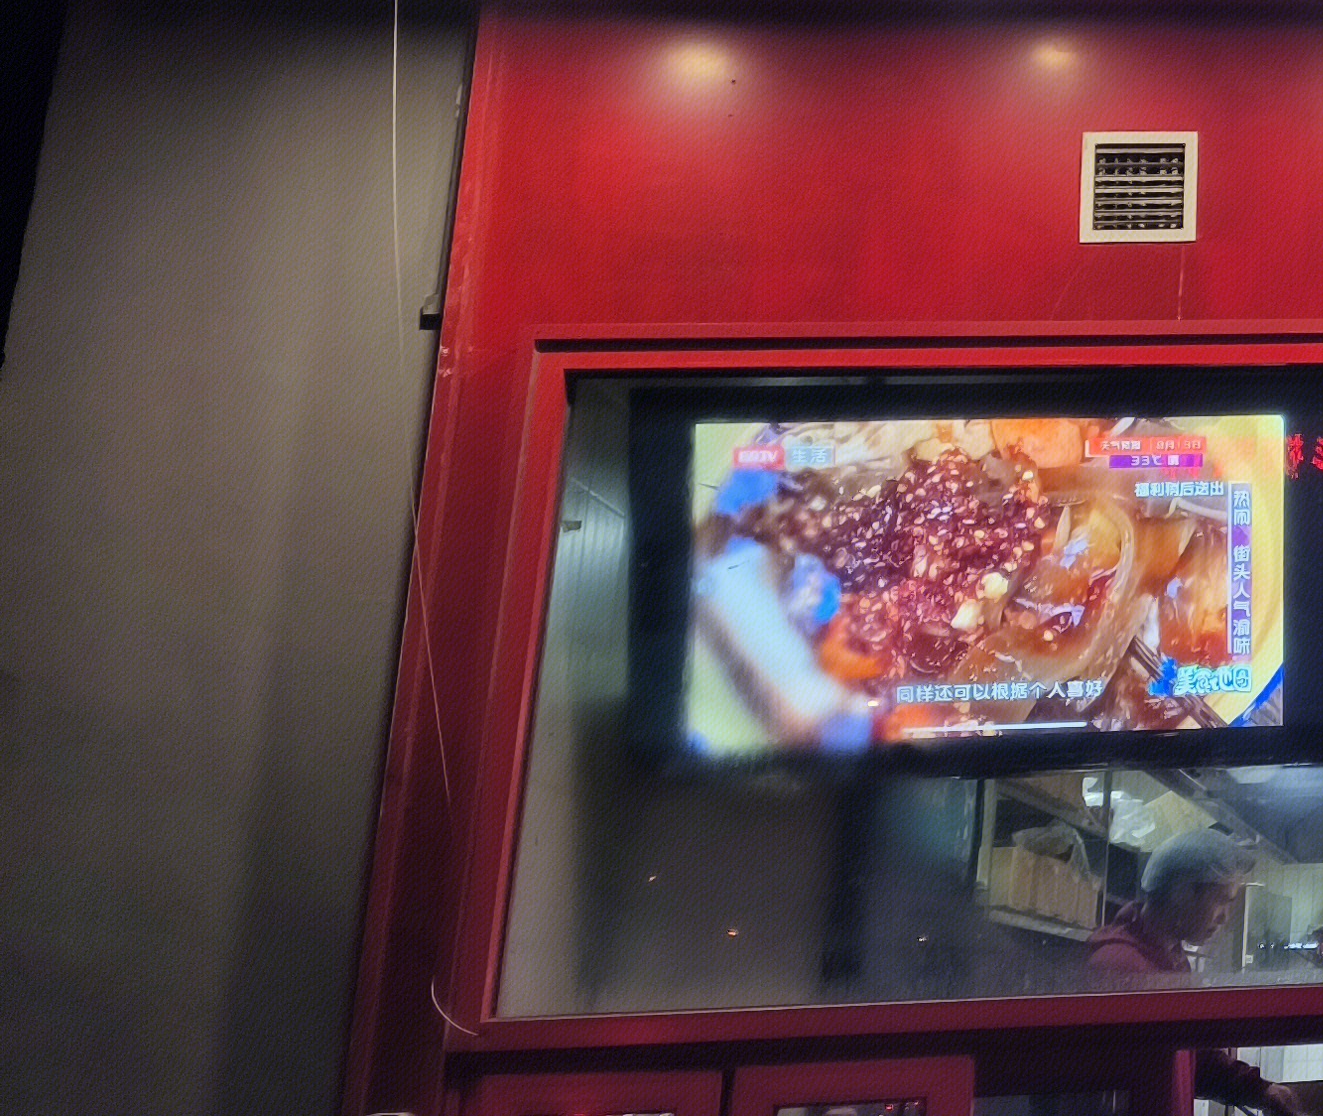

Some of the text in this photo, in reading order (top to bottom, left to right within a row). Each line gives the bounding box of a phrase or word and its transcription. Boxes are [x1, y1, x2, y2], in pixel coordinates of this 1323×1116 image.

[791, 448, 828, 463] 生活
[896, 680, 1104, 704] 同样还可以根据个人喜好
